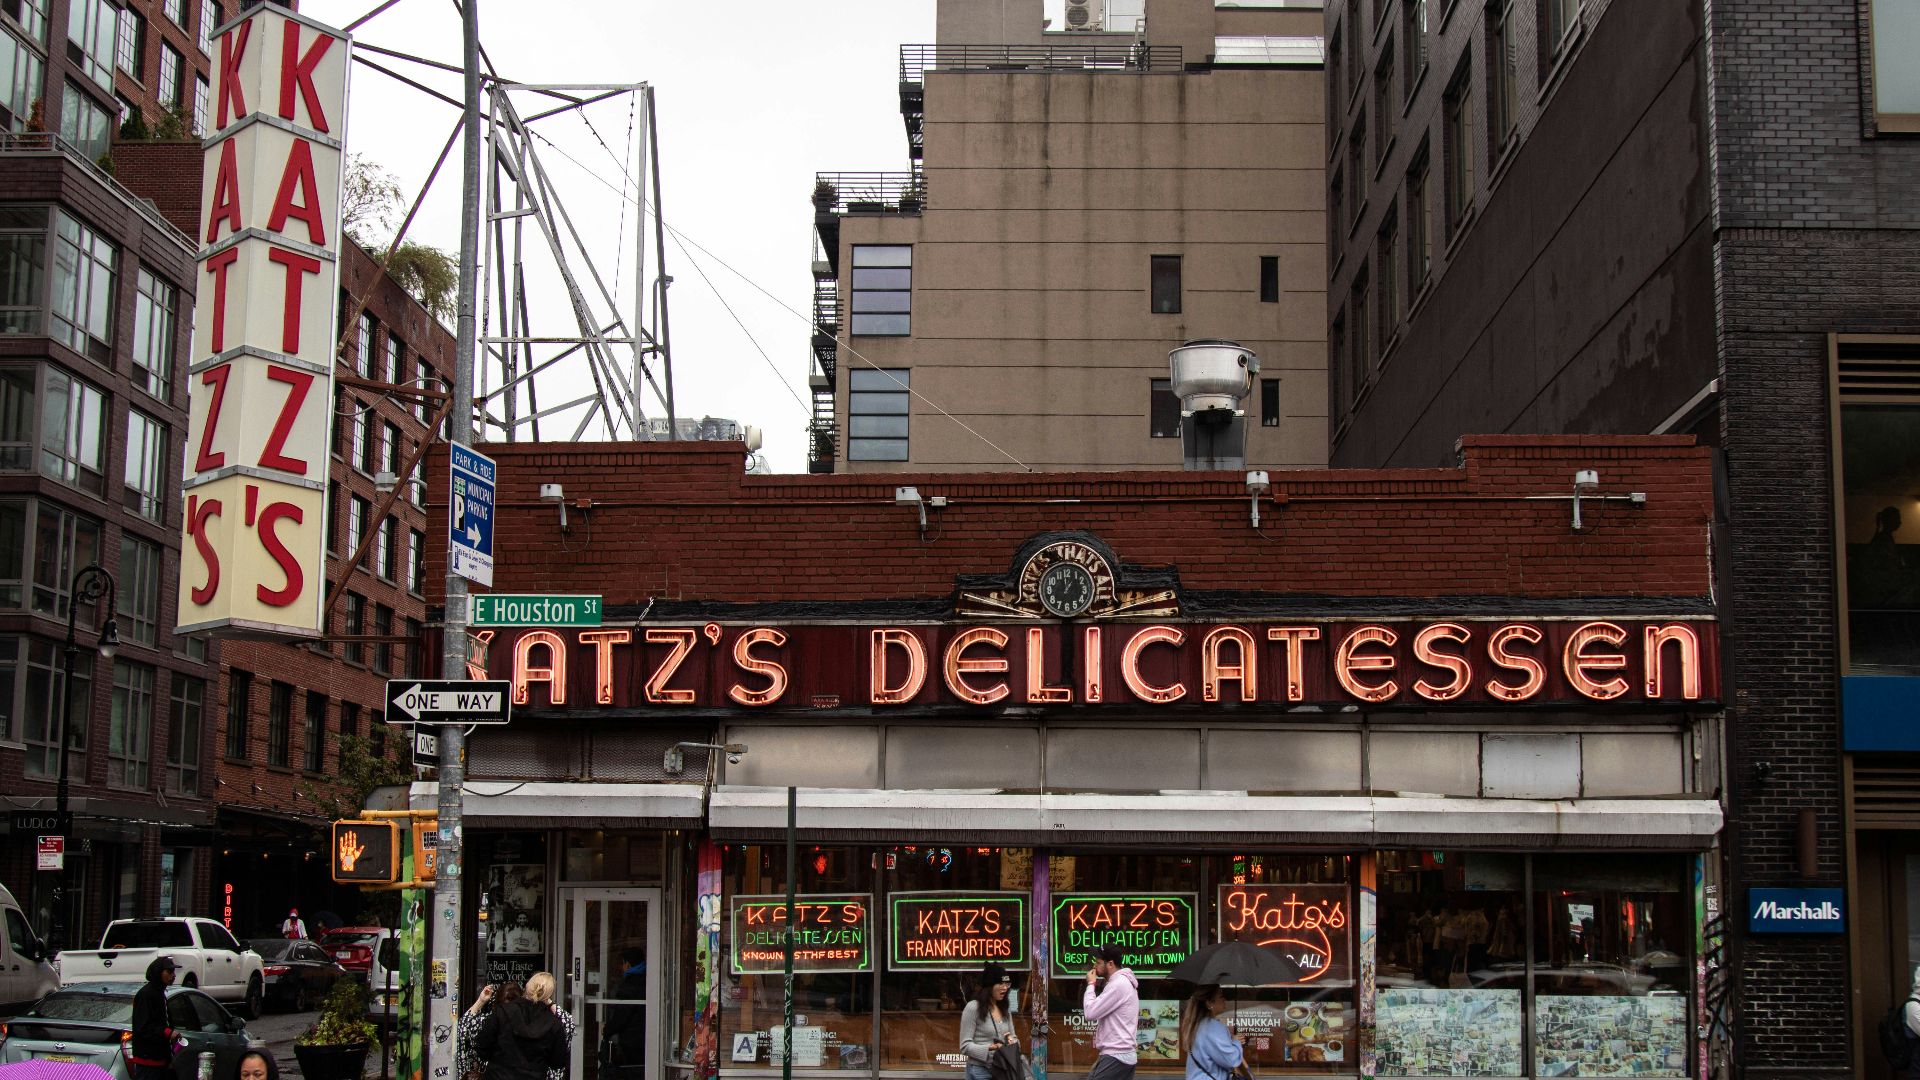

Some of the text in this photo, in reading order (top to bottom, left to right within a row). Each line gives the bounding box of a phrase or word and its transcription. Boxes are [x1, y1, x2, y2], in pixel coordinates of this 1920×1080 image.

[187, 19, 252, 606] KATZ'S
[245, 20, 334, 607] KATZ'S
[455, 452, 492, 480] PARK & RIDE
[467, 481, 492, 505] MUNICIPAL
[454, 493, 465, 530] P
[467, 499, 488, 520] PARKING
[1056, 571, 1063, 580] 11
[1063, 569, 1071, 578] 12
[1074, 571, 1078, 579] 1
[1048, 576, 1056, 585] 10
[1079, 576, 1085, 585] 2
[1046, 585, 1052, 595] 9
[1082, 585, 1087, 595] 3
[1049, 595, 1056, 604] 8
[1072, 600, 1078, 609] 5
[1078, 594, 1085, 604] 4
[476, 598, 597, 623] E Houston St
[1056, 601, 1063, 609] 7
[1064, 603, 1070, 612] 6
[871, 624, 1701, 704] DELICATESSEN
[405, 693, 494, 710] ONE WAY
[420, 736, 434, 754] ONE
[17, 817, 69, 829] LUDLO
[1070, 899, 1175, 929] KATZ'S
[1753, 901, 1841, 920] Marshalls
[918, 907, 1001, 934] KATZ'S
[1070, 930, 1180, 947] DELICATESSEN
[906, 939, 1012, 957] FRANKFURTERS
[743, 951, 784, 961] KNOWN
[1064, 953, 1088, 964] BEST
[1156, 953, 1185, 964] TOWN
[1299, 953, 1323, 968] ALL
[493, 960, 508, 971] Real
[510, 960, 534, 971] Taste
[488, 970, 527, 981] New York
[1063, 1015, 1099, 1026] HOLID
[1226, 1018, 1281, 1027] HANUKKAH
[736, 1036, 753, 1054] A
